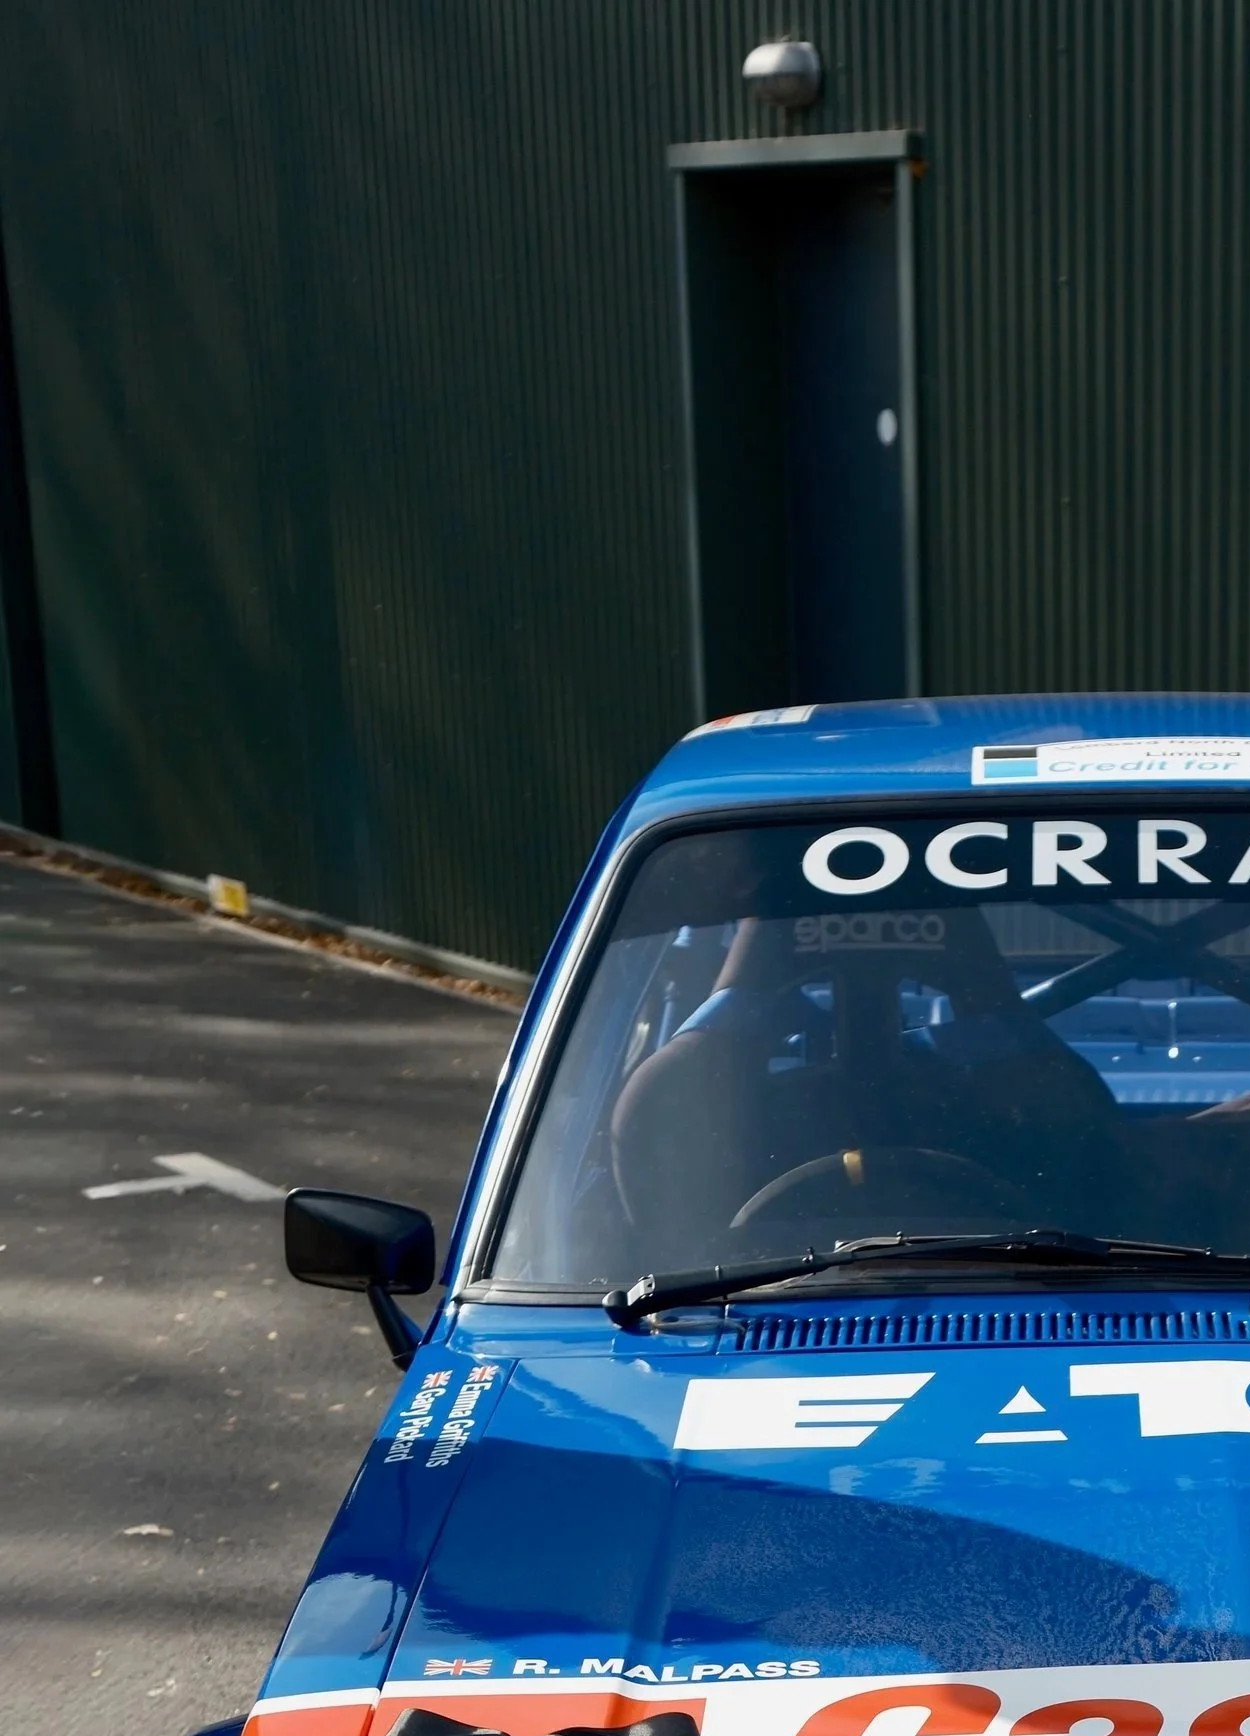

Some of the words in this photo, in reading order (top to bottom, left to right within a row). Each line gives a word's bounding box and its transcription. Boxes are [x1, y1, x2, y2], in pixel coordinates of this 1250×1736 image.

[1048, 760, 1168, 773] Credit
[1182, 760, 1238, 771] for
[793, 912, 946, 954] sparco
[400, 1387, 447, 1417] Gary
[448, 1382, 492, 1419] Emma
[383, 1415, 434, 1463] Pickard
[512, 1658, 560, 1675] R.
[580, 1657, 821, 1682] MALPASS
